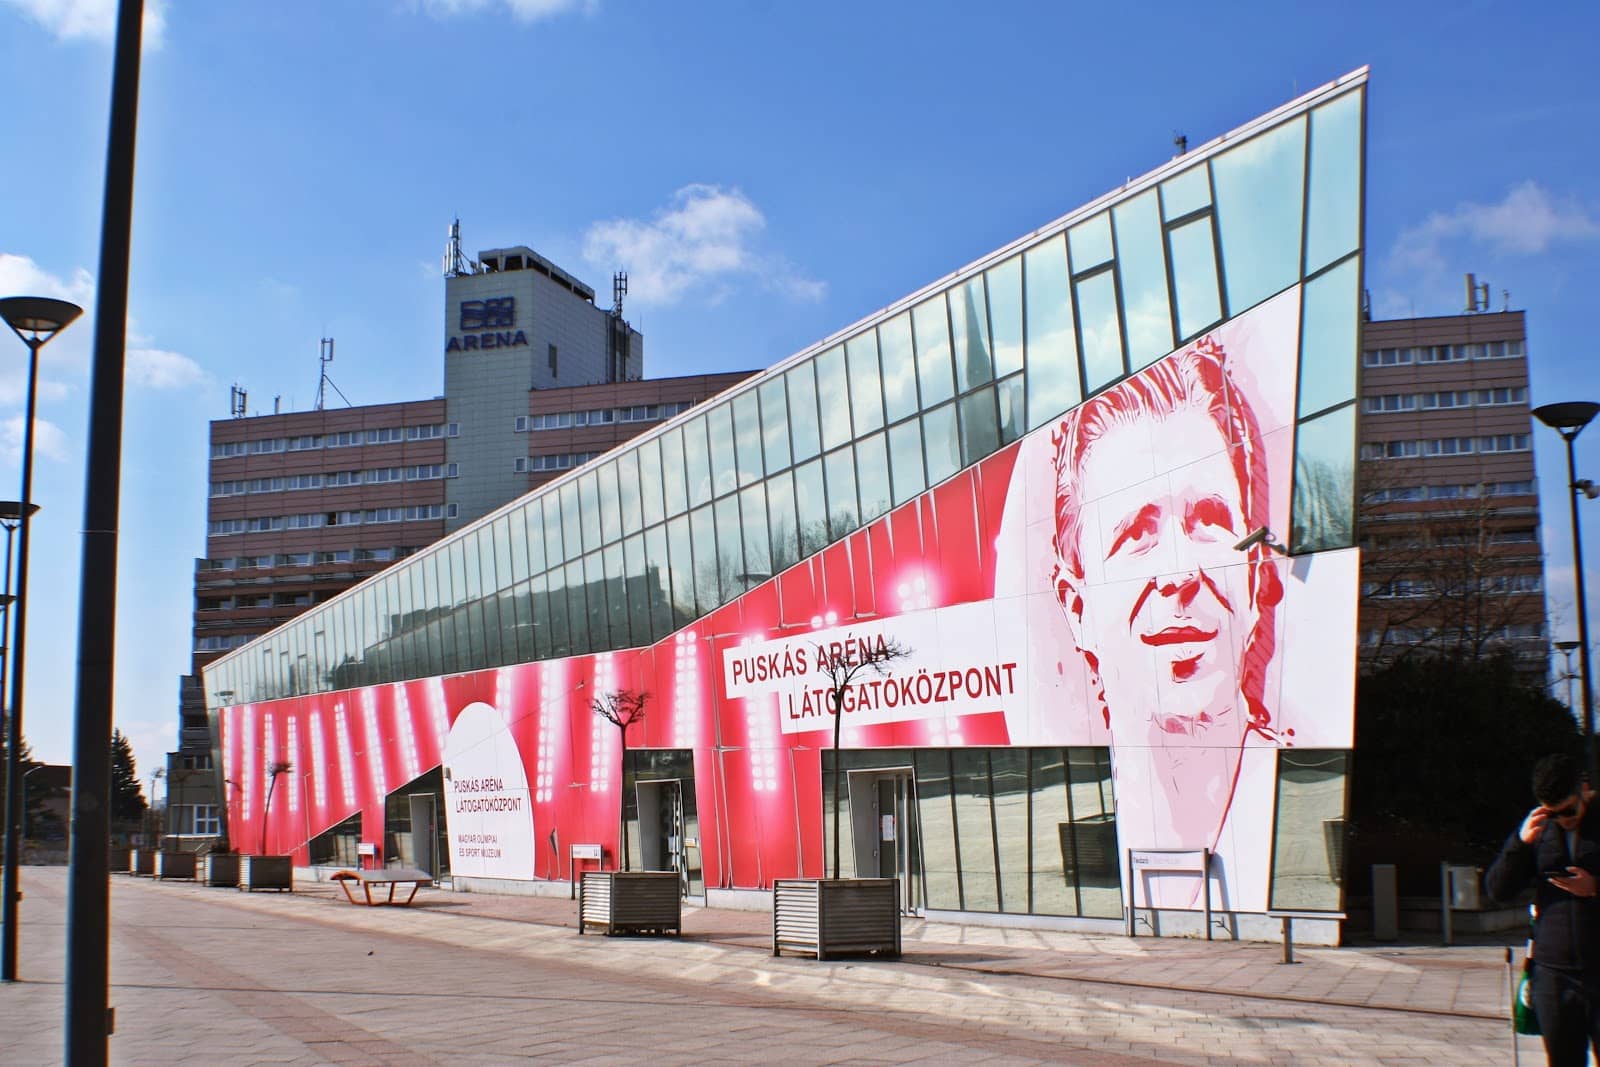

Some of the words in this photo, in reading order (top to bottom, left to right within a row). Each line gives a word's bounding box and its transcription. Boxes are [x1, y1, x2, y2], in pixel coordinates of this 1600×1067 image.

[447, 330, 529, 352] ARENA
[732, 644, 807, 686] PUSKÁS
[816, 632, 890, 673] ARÉNA
[789, 663, 1017, 719] LÁTOGATÓKÖZPONT
[454, 776, 479, 793] PUSKÁS
[481, 776, 503, 792] ARÉNA
[456, 796, 521, 813] LÁTOGATÓKÖZPONT
